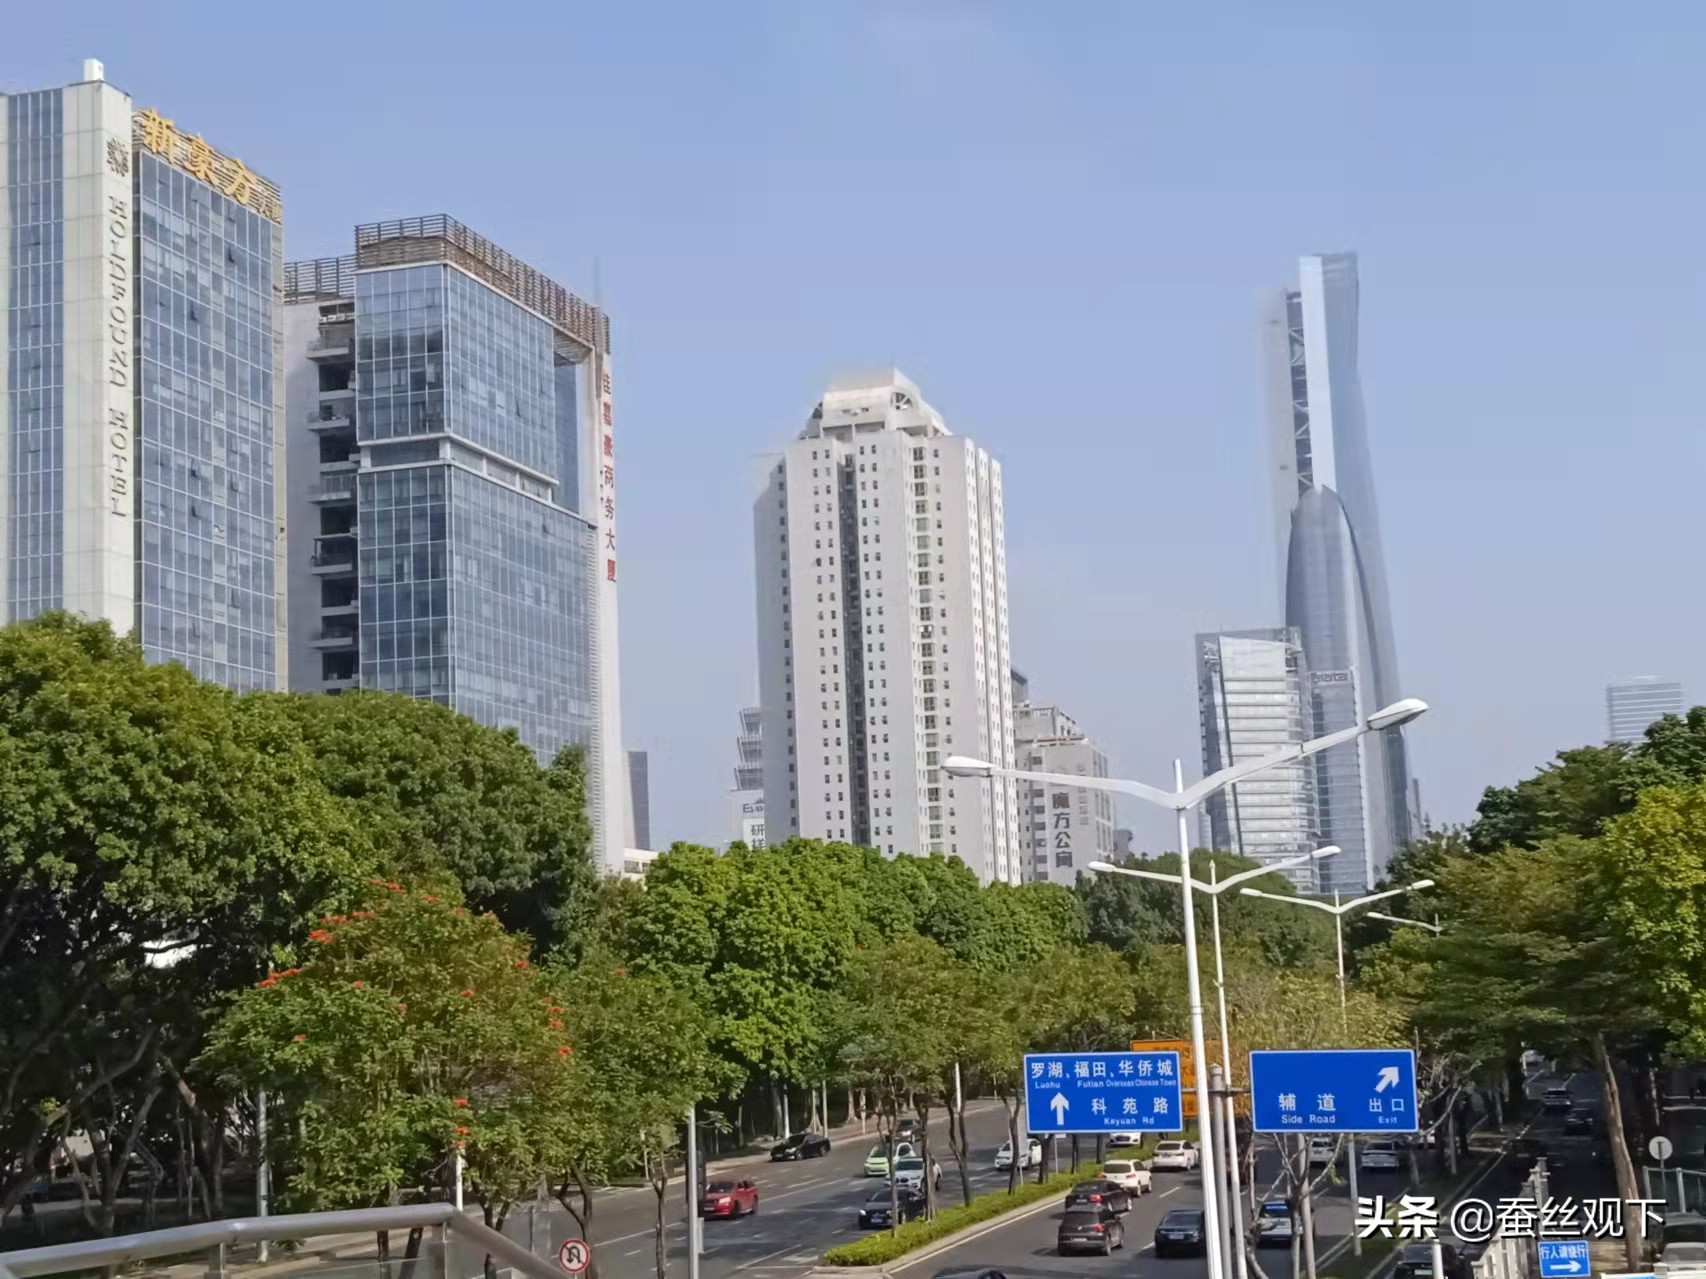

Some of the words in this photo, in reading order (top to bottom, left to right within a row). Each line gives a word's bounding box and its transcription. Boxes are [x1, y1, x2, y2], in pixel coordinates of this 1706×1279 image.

[109, 408, 130, 518] HOTEL
[1052, 791, 1073, 868] 魔方公寓
[1035, 1081, 1061, 1089] Luohu
[1077, 1080, 1105, 1088] Futian
[1160, 1078, 1176, 1086] Town
[1091, 1096, 1169, 1115] 科苑路
[1278, 1092, 1336, 1112] 辅道
[1369, 1097, 1405, 1113] 出口
[1142, 1116, 1155, 1125] Rd
[1281, 1115, 1303, 1124] Side
[1309, 1114, 1336, 1124] Road
[1378, 1116, 1398, 1124] Exit
